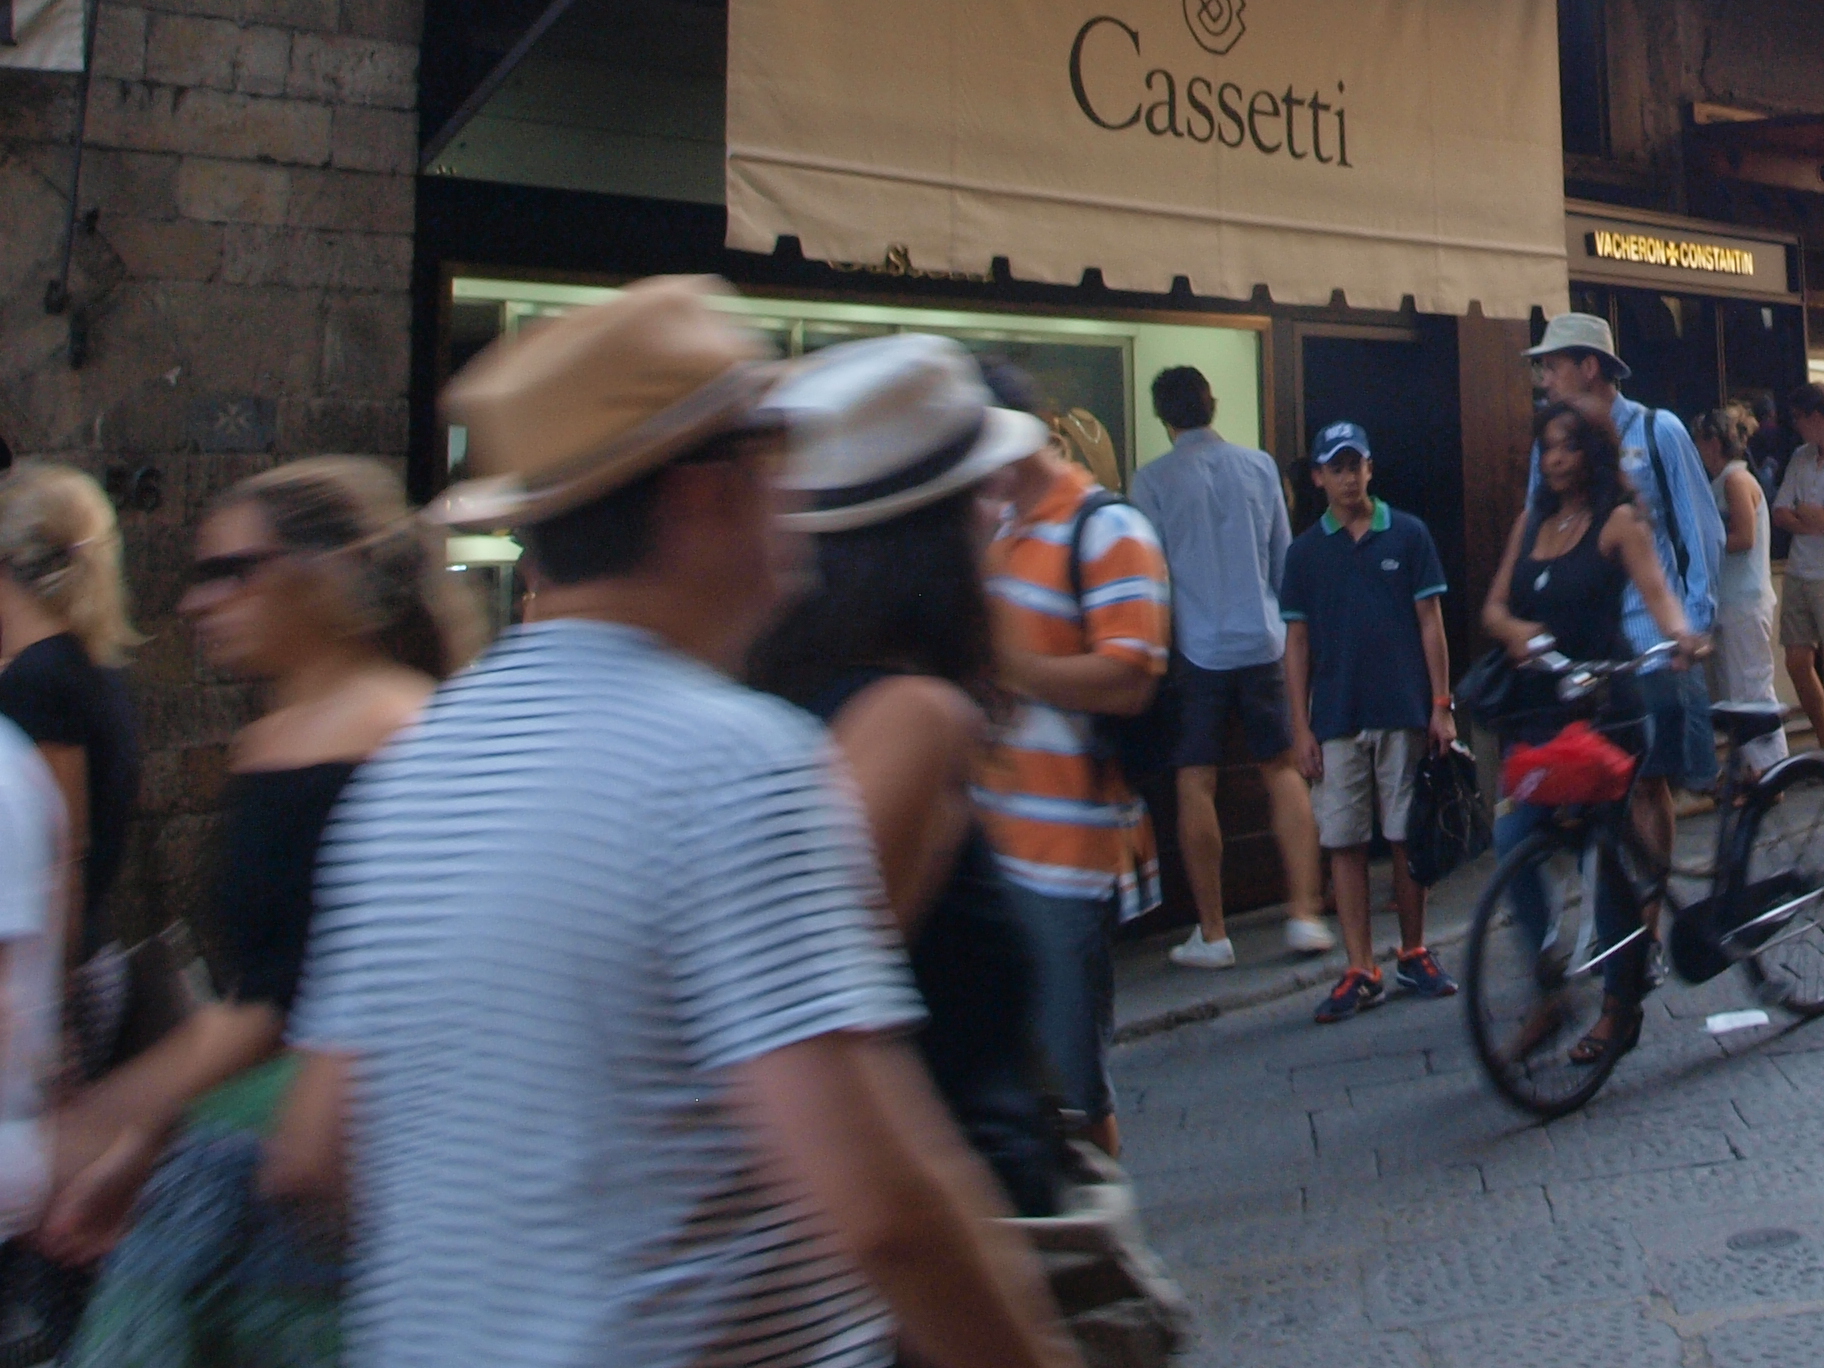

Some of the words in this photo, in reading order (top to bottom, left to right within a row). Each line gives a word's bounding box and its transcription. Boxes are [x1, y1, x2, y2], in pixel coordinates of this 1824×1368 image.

[1069, 14, 1353, 169] Cassetti
[1595, 230, 1667, 265] VACHERON
[1679, 241, 1754, 276] CONSTANTIN
